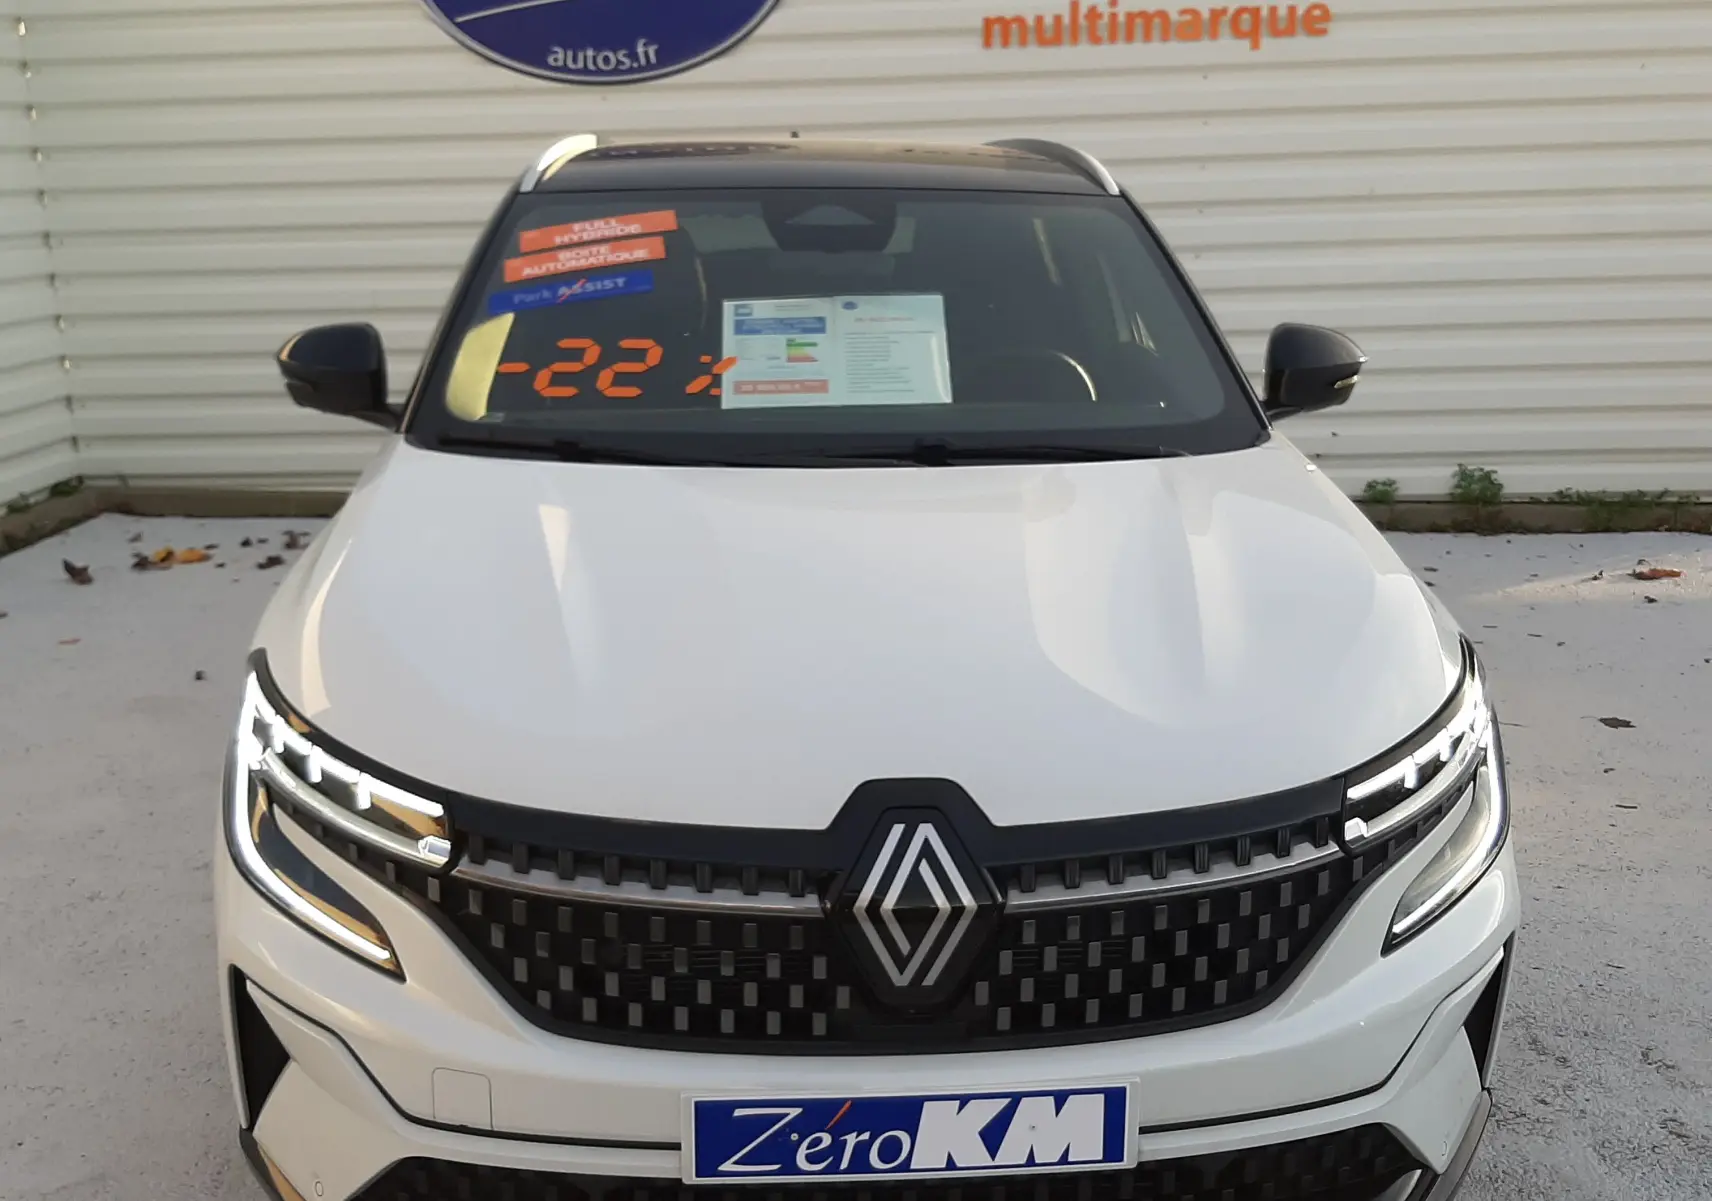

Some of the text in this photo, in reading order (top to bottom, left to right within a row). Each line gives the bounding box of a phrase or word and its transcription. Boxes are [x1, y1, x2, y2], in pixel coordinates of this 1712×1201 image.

[982, 0, 1332, 50] multimarque
[547, 39, 659, 71] autos.fr
[571, 218, 620, 233] FULL
[521, 248, 650, 277] AUTOMATIQUE
[513, 288, 553, 304] Park
